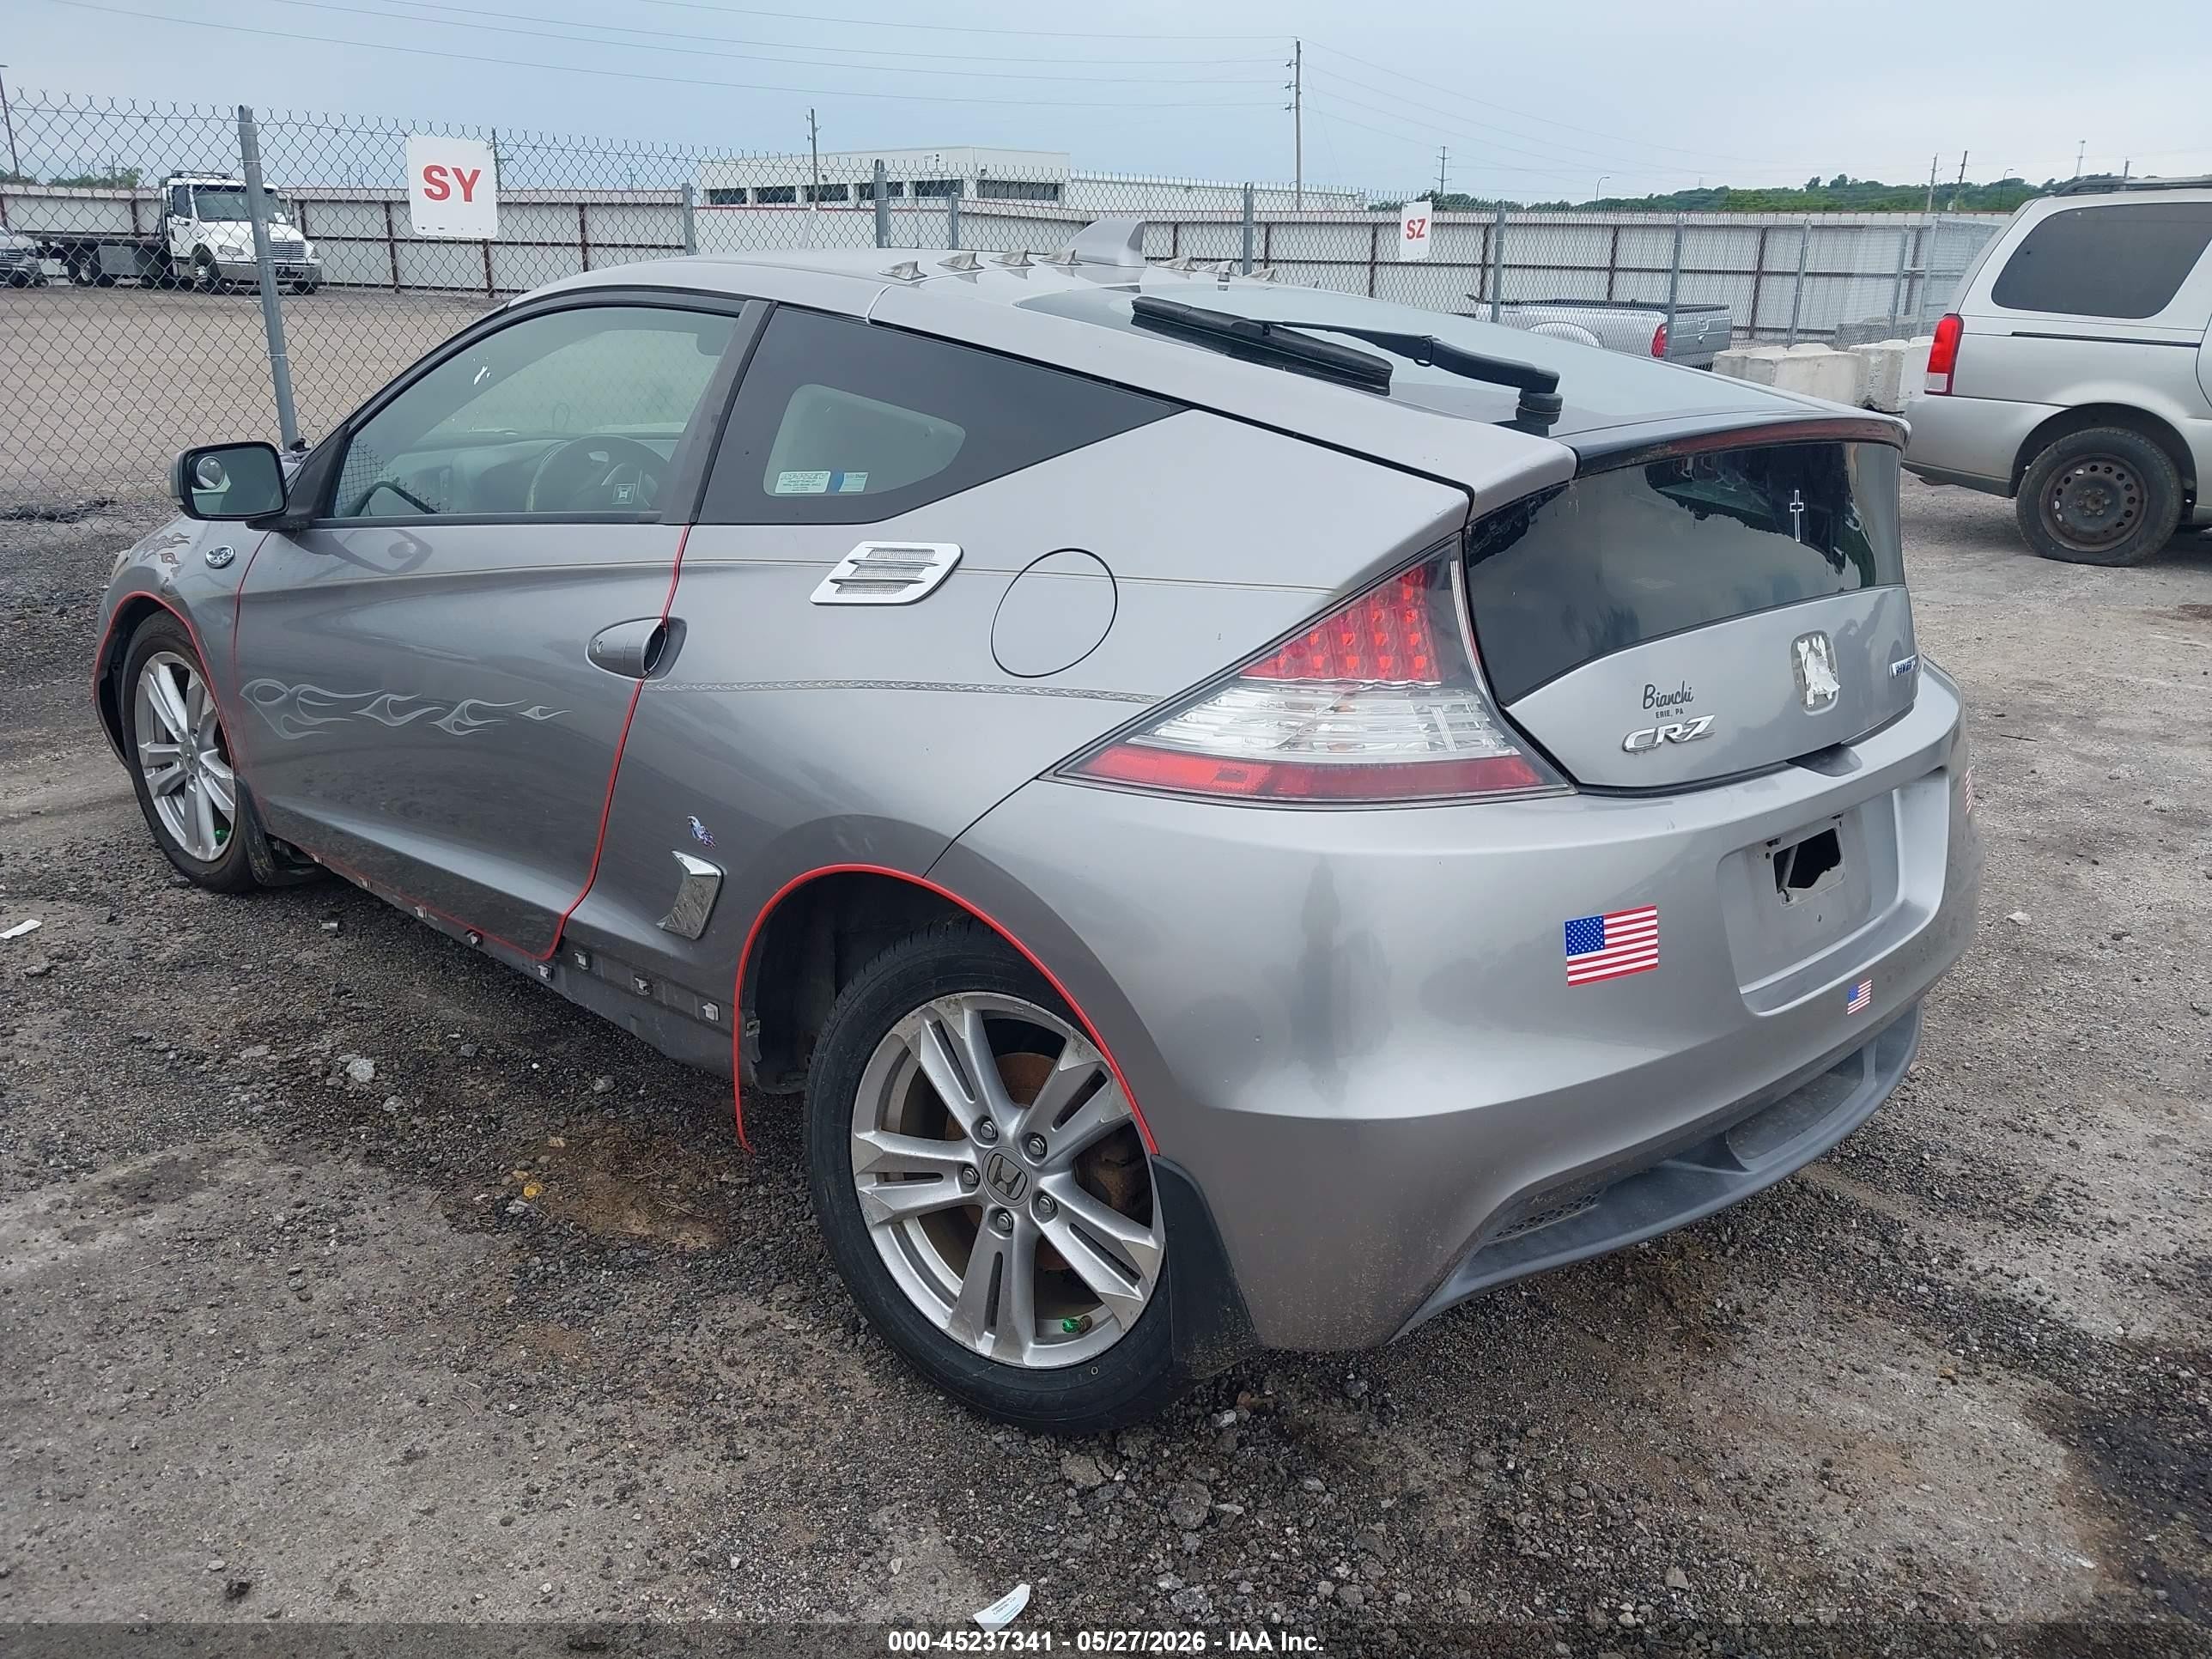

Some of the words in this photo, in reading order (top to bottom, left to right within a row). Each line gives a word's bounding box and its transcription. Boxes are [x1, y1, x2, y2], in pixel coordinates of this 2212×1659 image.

[422, 164, 482, 203] SY
[1406, 218, 1426, 240] SZ
[1642, 680, 1694, 710] Bianchi
